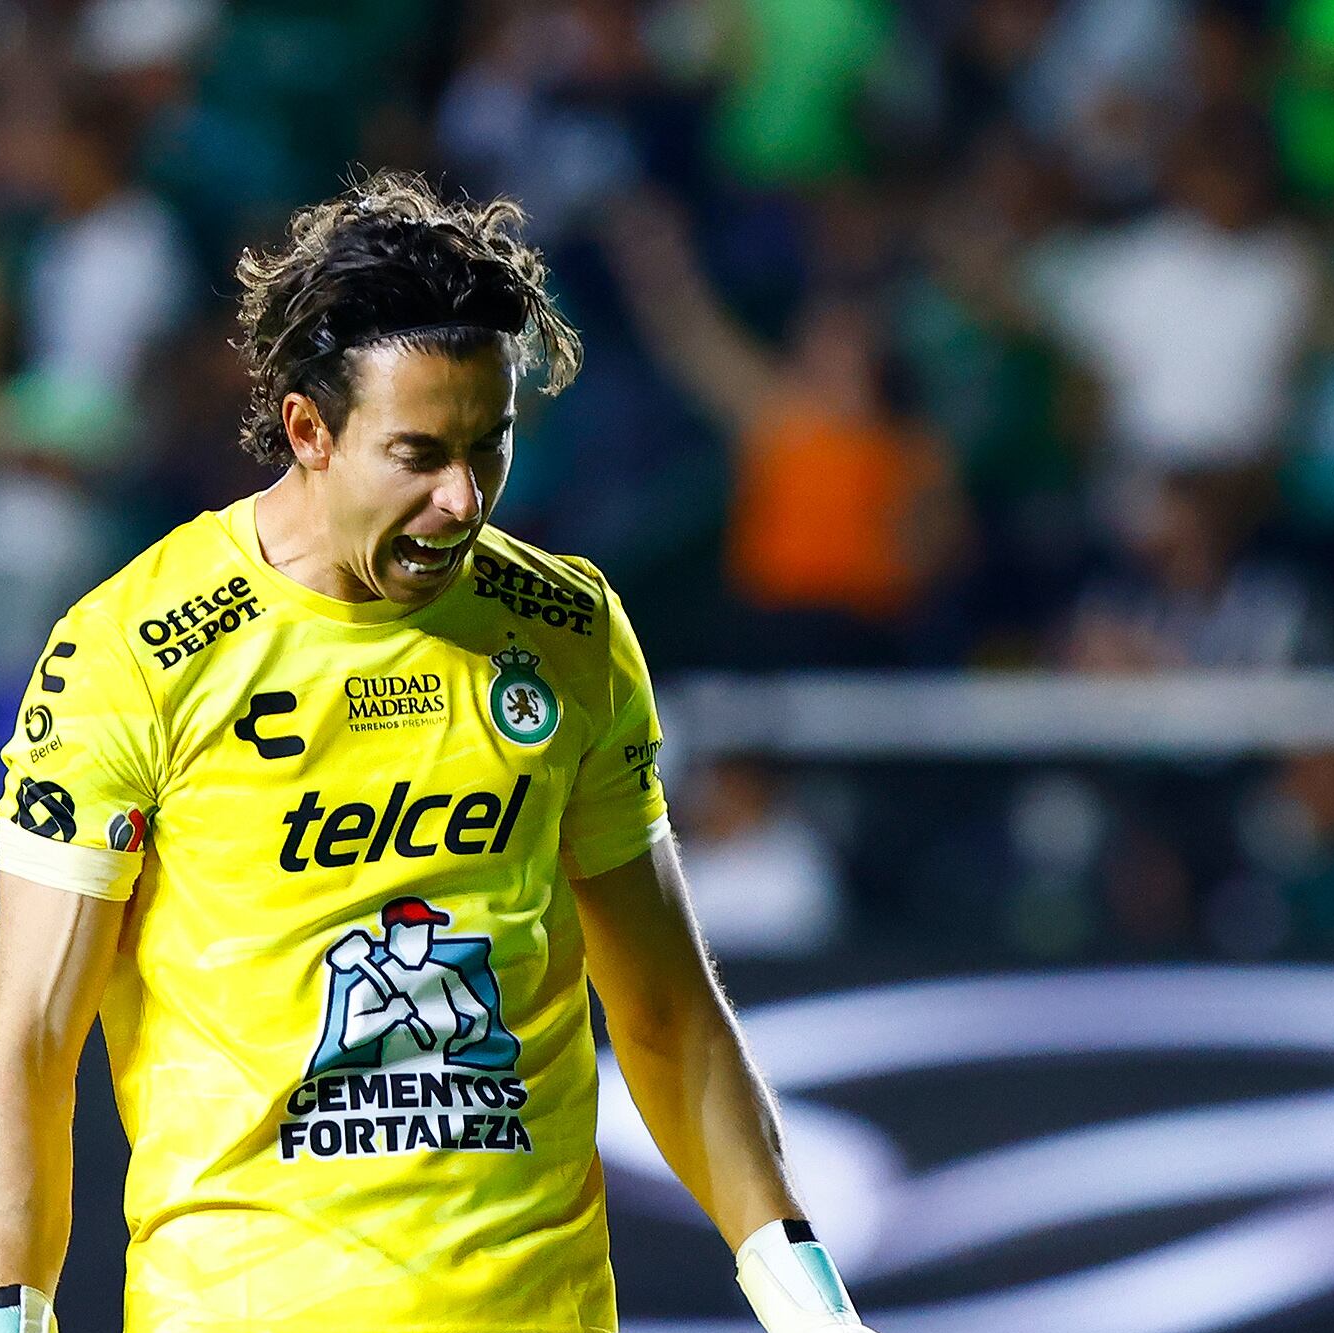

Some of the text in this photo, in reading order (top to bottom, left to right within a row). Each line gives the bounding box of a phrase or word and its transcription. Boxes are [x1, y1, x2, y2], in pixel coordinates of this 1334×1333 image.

[139, 576, 252, 646] Office
[344, 673, 441, 699] CIUDAD
[348, 695, 445, 719] MADERAS
[349, 716, 447, 732] TERRENOS PREMIUM
[30, 734, 63, 764] Berel
[279, 774, 532, 873] telcel
[286, 1072, 528, 1116] CEMENTOS
[279, 1114, 532, 1160] FORTALEZA
